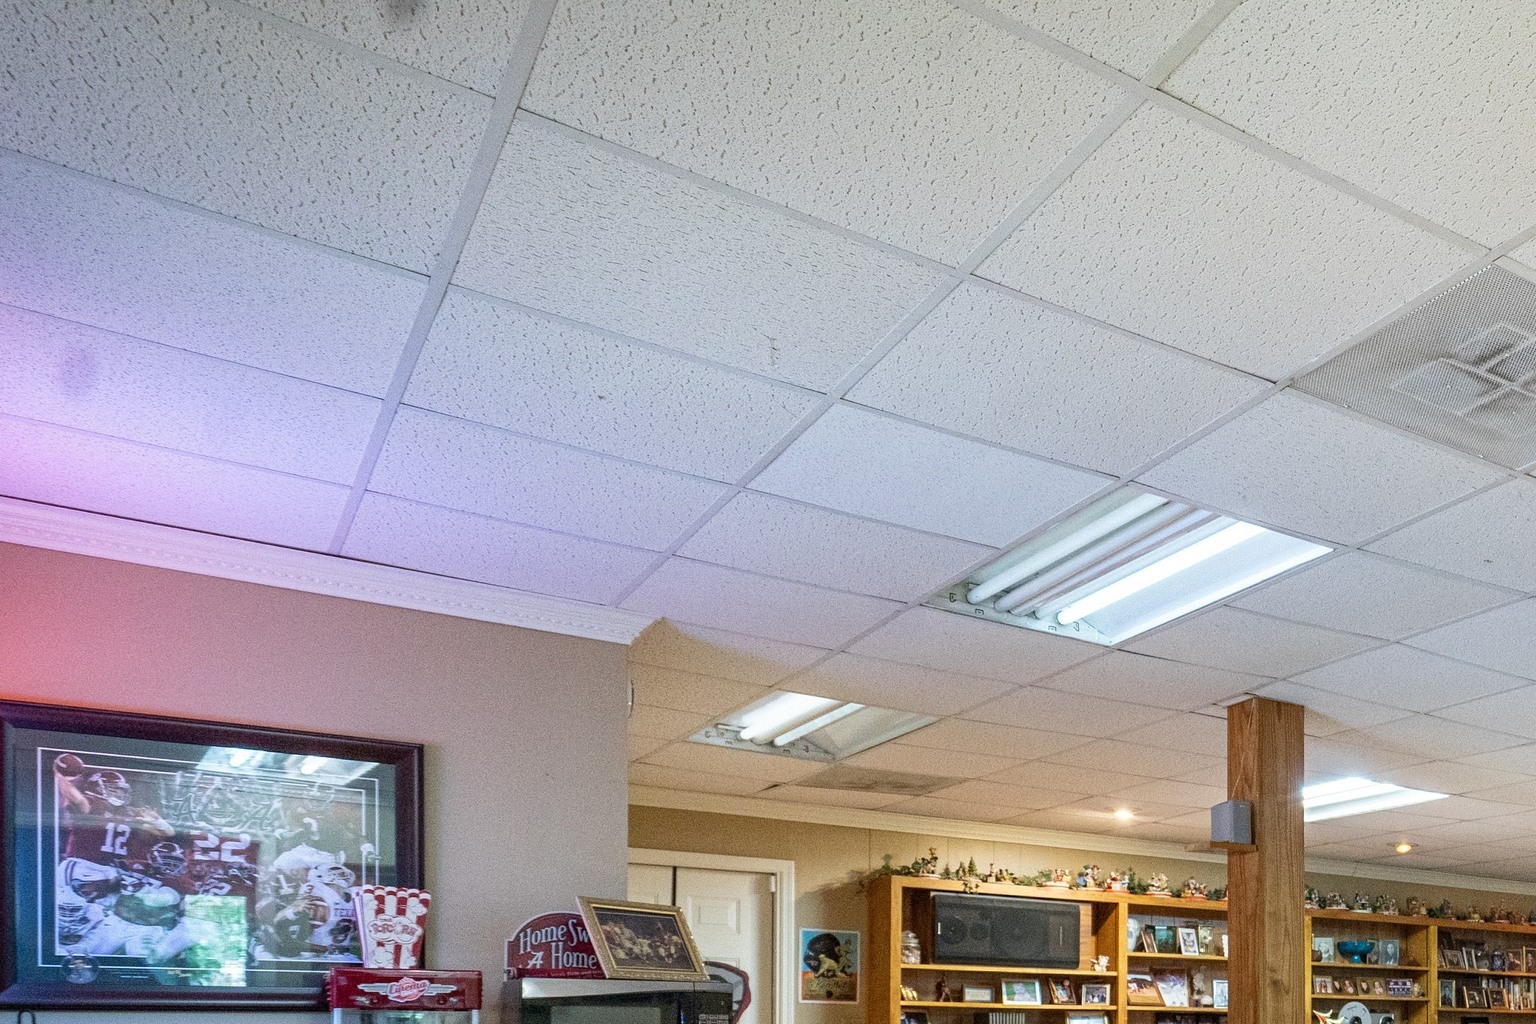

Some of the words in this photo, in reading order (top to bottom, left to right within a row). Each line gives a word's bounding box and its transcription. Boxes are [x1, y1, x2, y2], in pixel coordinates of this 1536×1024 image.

[101, 822, 132, 856] 12
[519, 925, 567, 954] Home
[551, 942, 597, 969] Home
